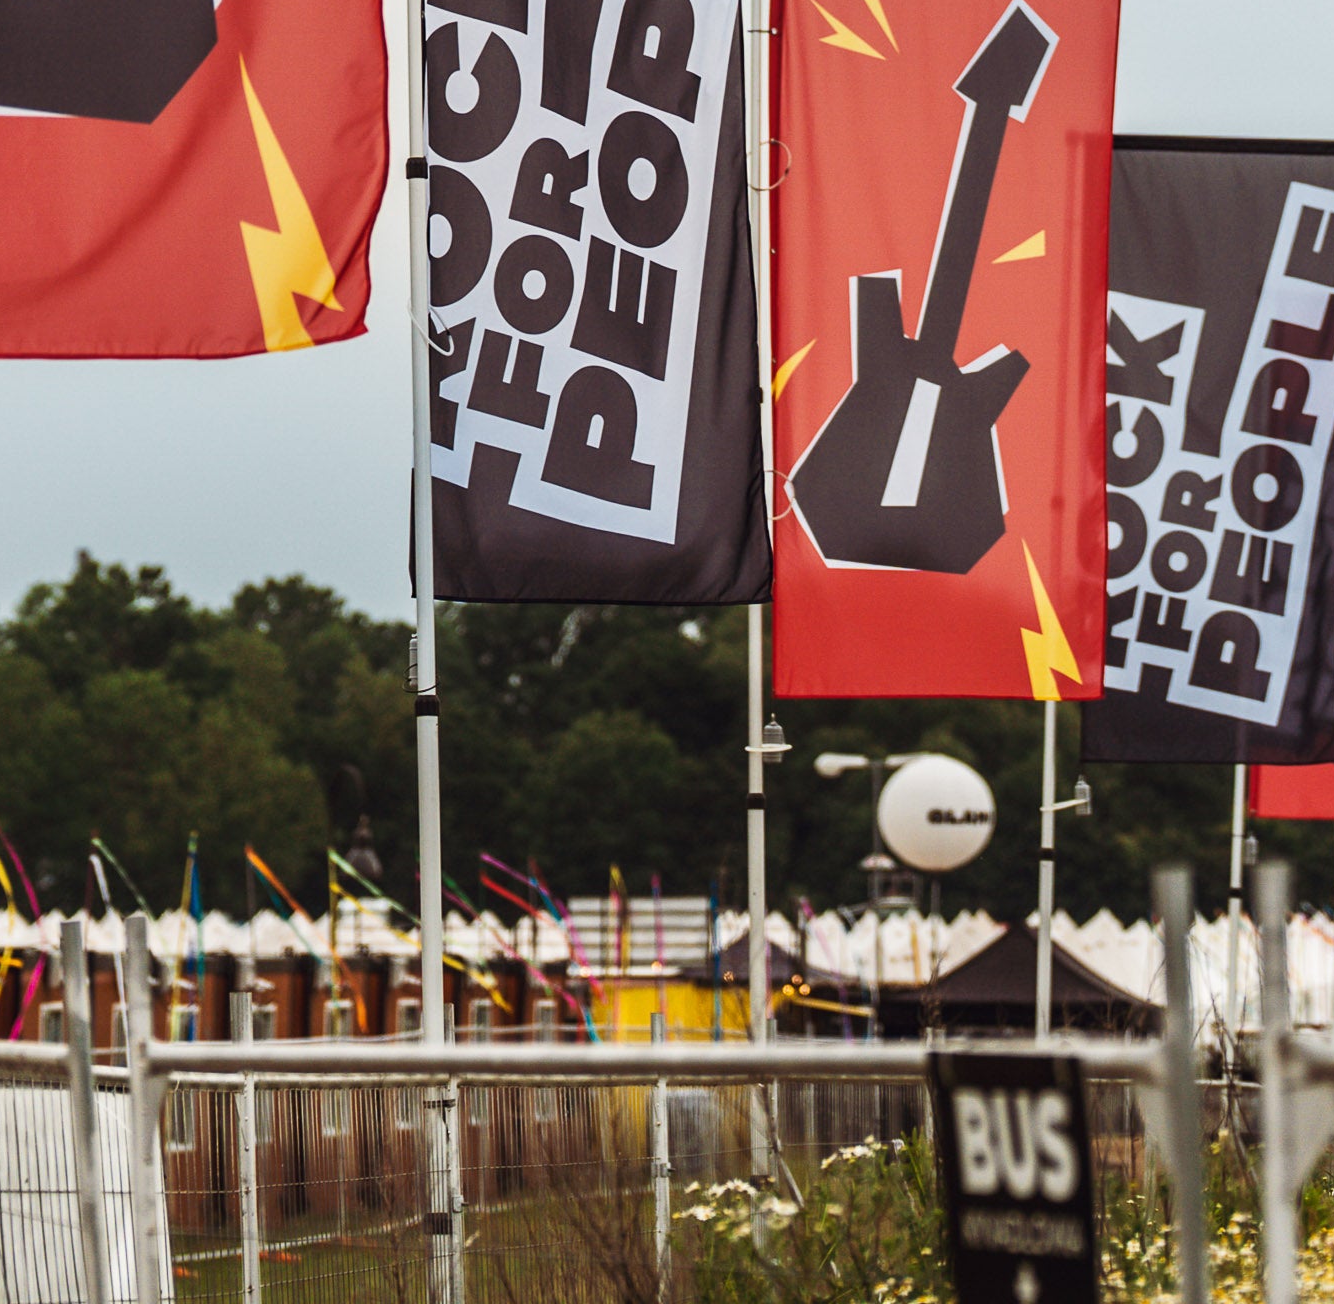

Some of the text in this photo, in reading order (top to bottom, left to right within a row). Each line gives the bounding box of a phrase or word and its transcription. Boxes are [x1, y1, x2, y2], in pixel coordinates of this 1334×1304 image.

[466, 137, 590, 431] FOR
[1135, 469, 1224, 654] FOR
[956, 1090, 1081, 1200] BUS
